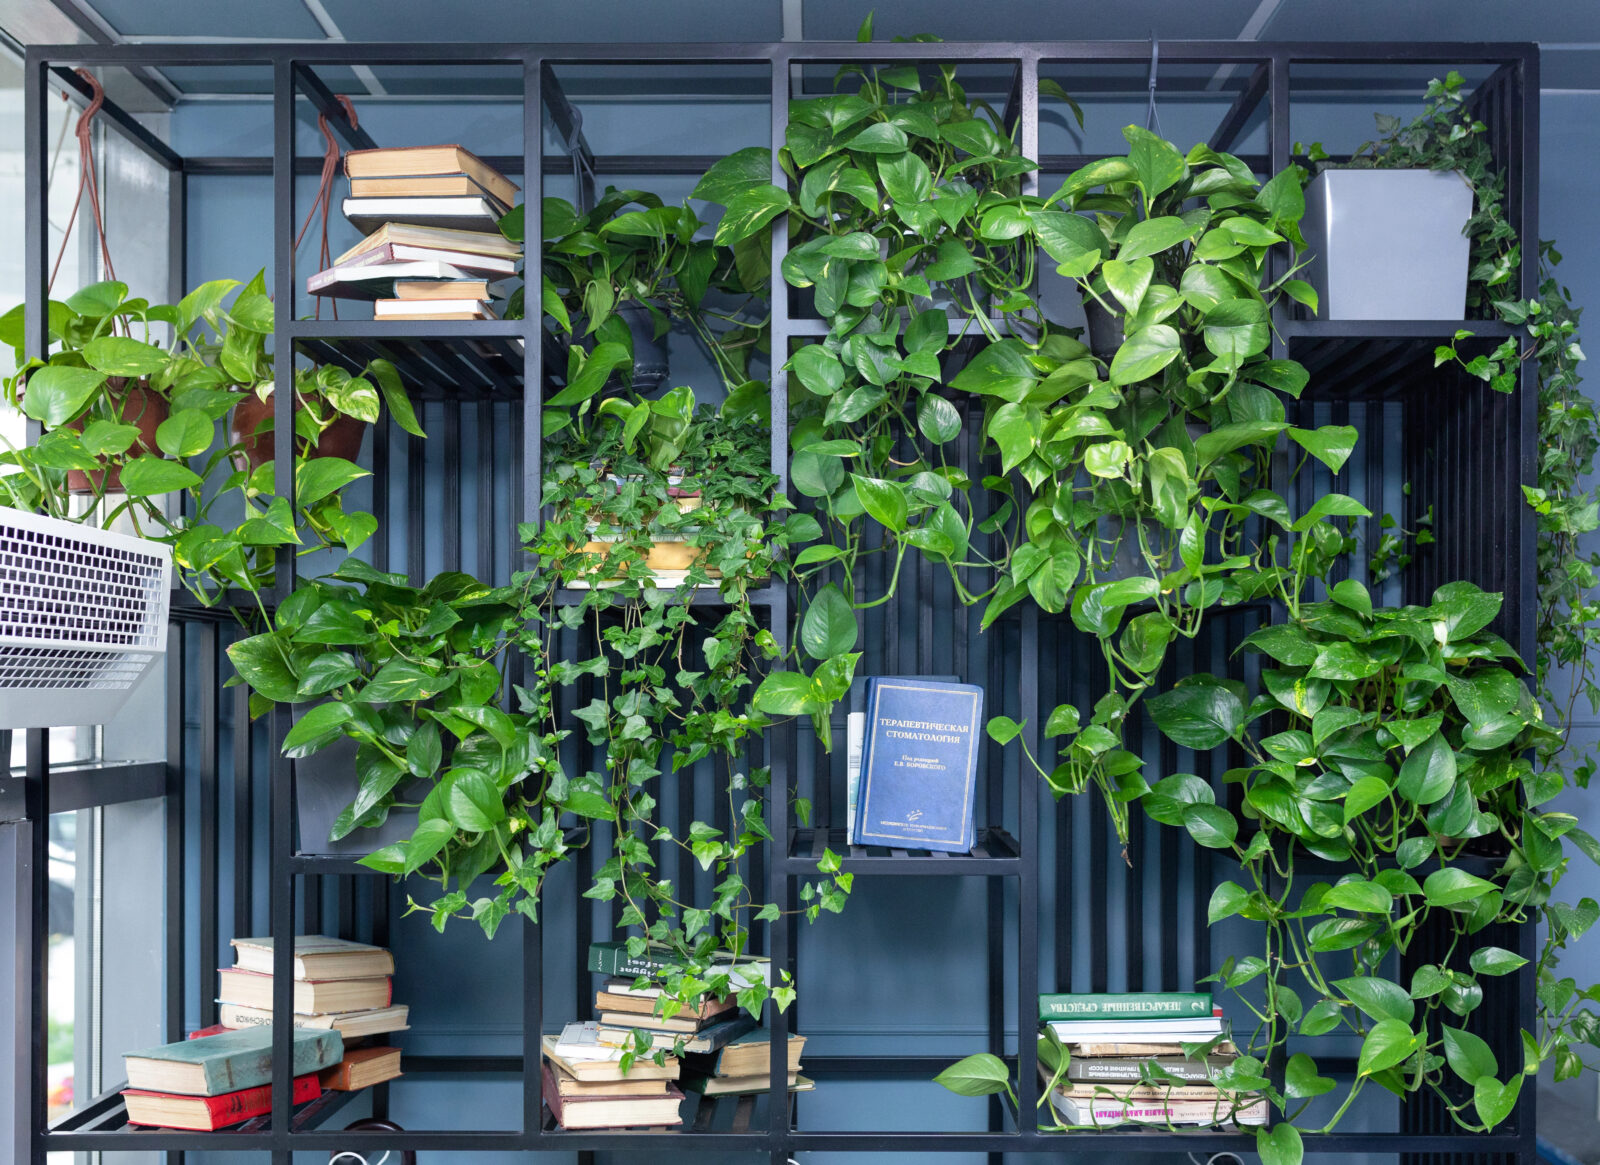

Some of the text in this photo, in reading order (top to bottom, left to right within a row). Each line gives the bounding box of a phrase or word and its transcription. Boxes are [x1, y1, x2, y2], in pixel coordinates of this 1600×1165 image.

[880, 718, 969, 733] ТЕРАПЕВТИЧЕСКАЯ
[886, 730, 961, 744] СТОМАТОЛОГИЯ
[1050, 1001, 1181, 1013] ЛЕКАРСТВЕННЫЕ СРЕДСТВА
